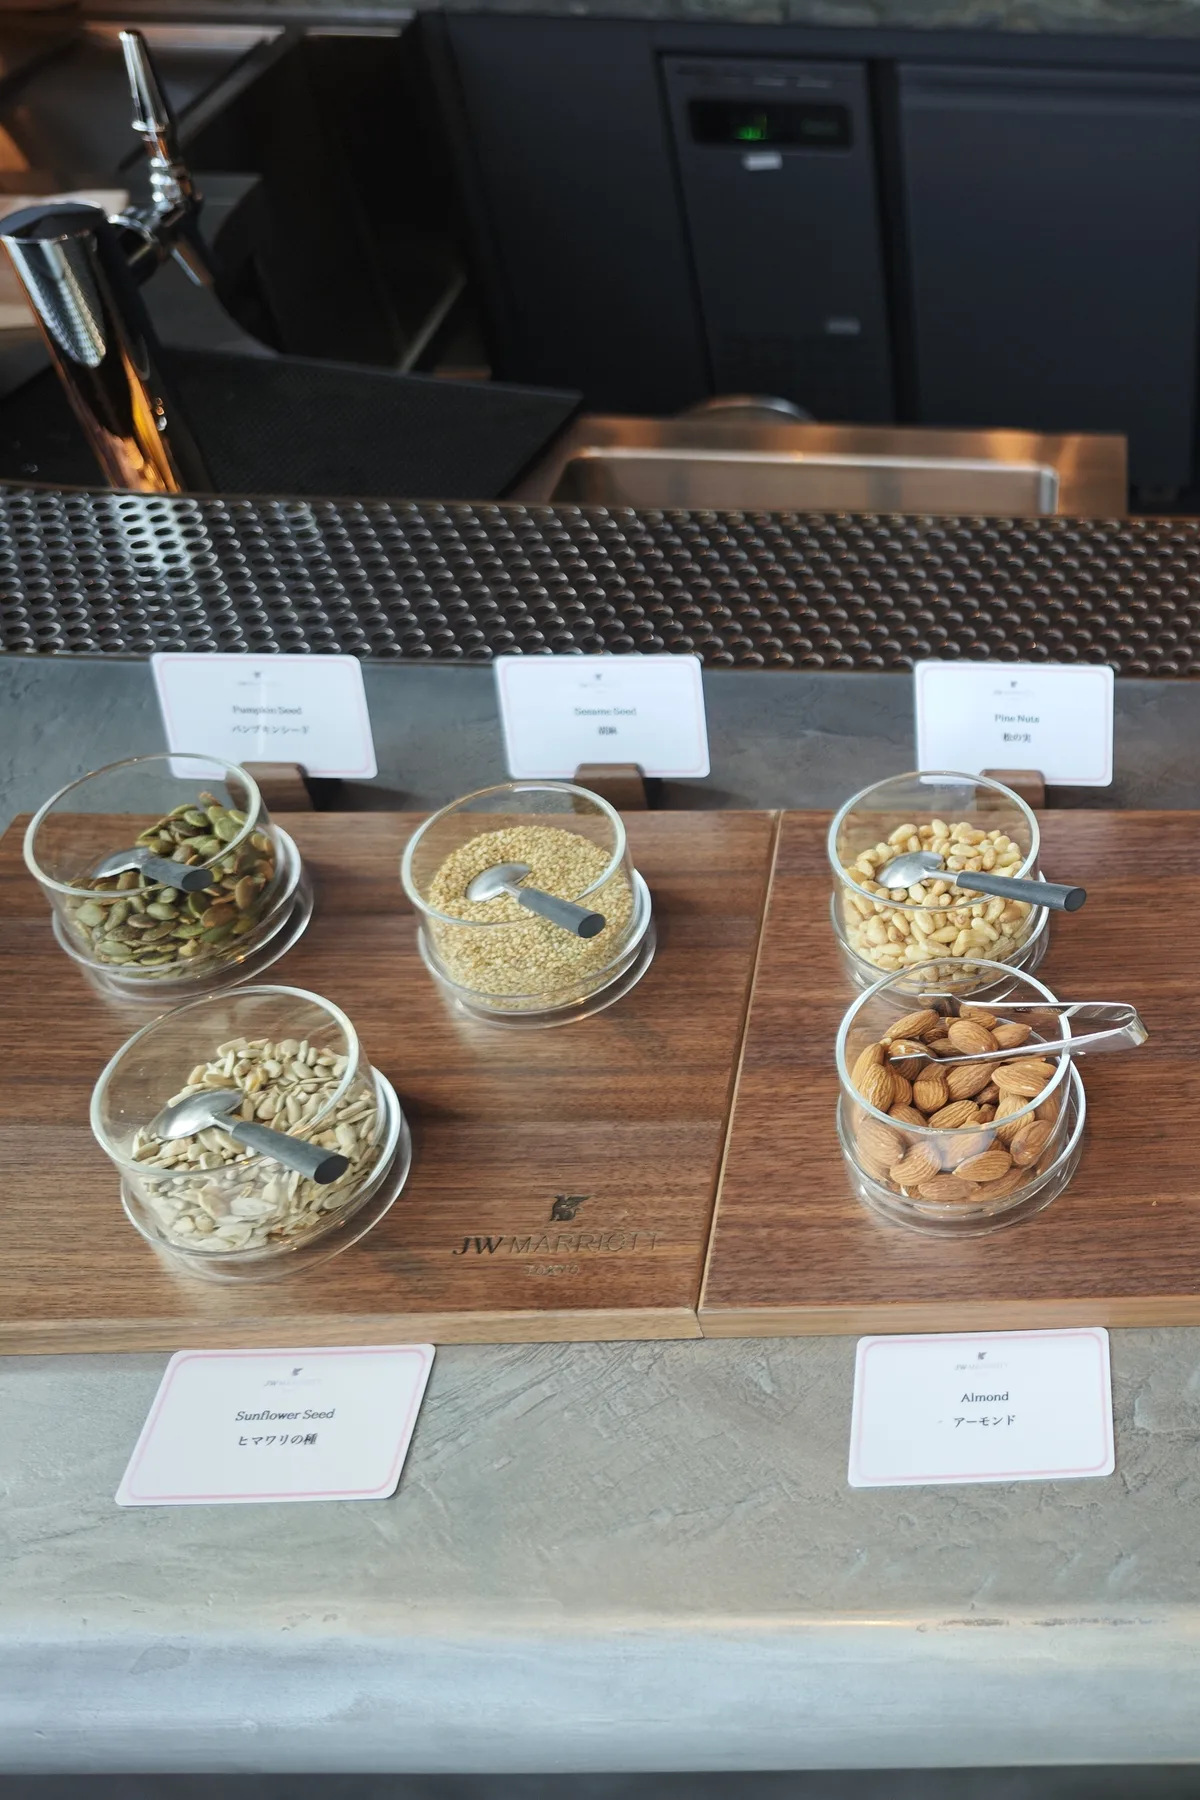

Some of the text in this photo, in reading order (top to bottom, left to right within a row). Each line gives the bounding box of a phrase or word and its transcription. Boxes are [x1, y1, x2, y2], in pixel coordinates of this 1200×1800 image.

[994, 713, 1015, 722] Pine
[453, 1230, 664, 1255] JW MARRIOTT
[960, 1391, 1010, 1403] Almond
[235, 1408, 336, 1422] Sunflower Seed
[953, 1414, 1016, 1428] アーモンド
[238, 1432, 318, 1446] ヒマワリの種
